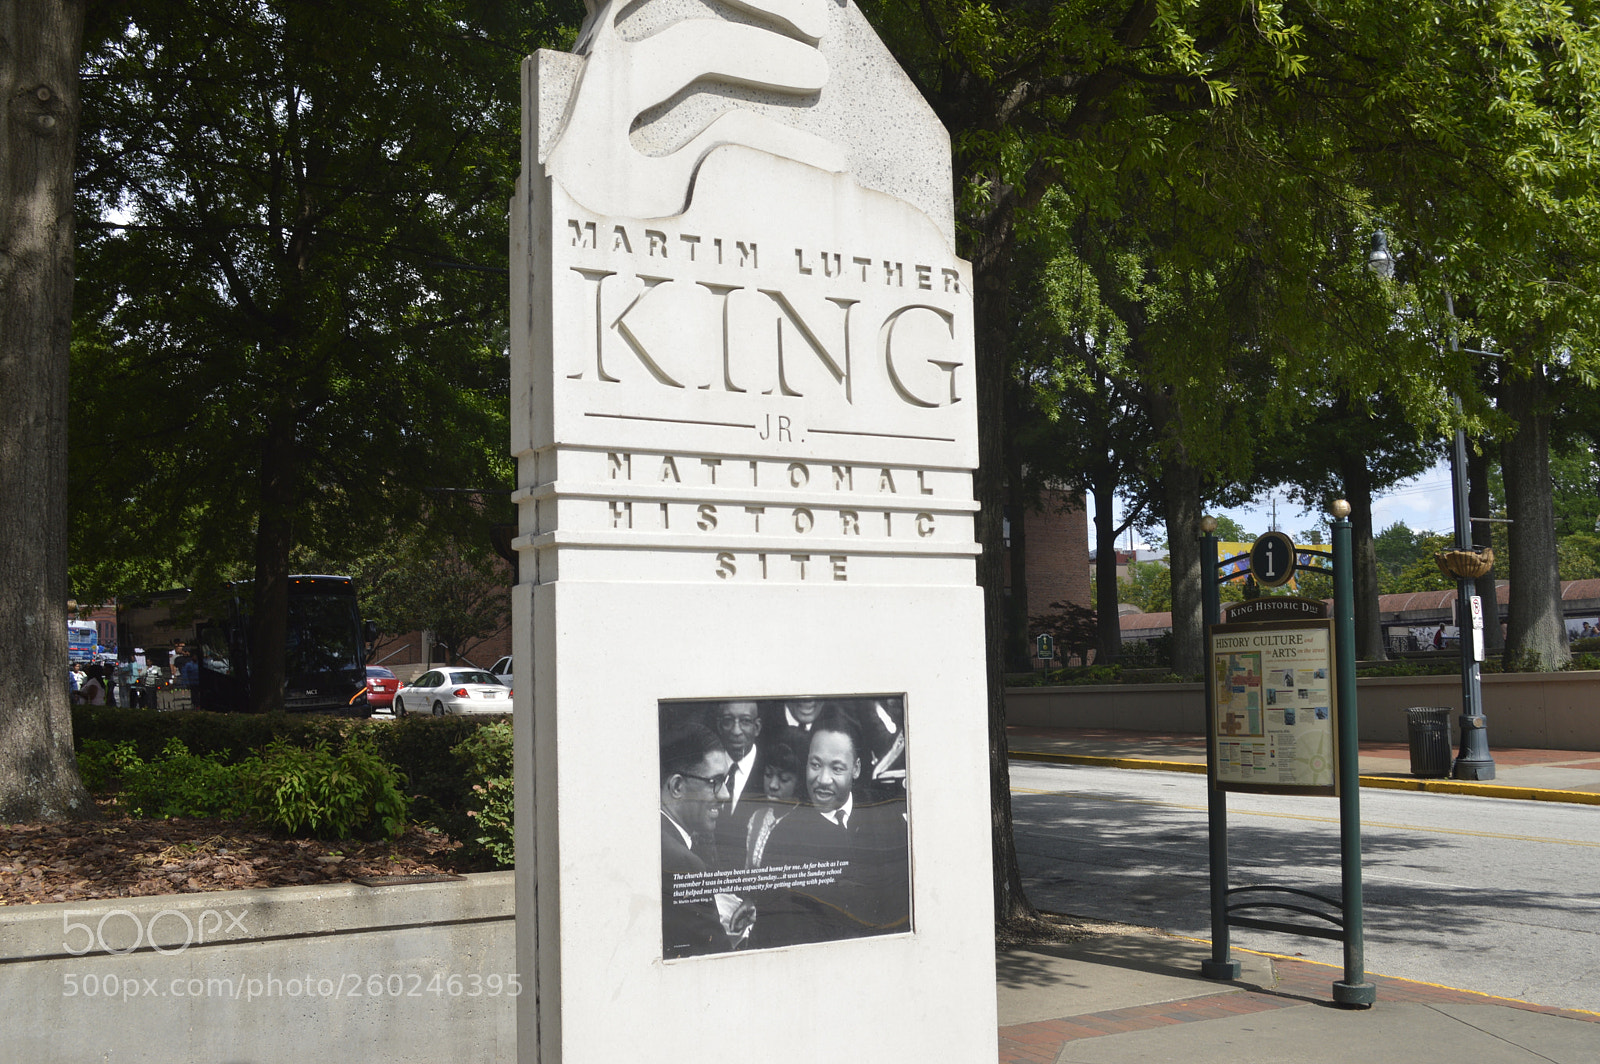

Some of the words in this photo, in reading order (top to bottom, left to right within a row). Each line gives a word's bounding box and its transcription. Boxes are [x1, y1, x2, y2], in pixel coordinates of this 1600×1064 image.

[568, 219, 758, 268] MARTIN
[795, 249, 961, 294] LUTHER
[566, 266, 964, 408] KING
[759, 413, 806, 443] JR.
[607, 452, 935, 496] NATIONAL
[609, 501, 936, 538] HISTORIC
[715, 551, 848, 582] SITE
[1231, 605, 1253, 618] KING
[1256, 602, 1298, 611] HISTORIC
[1216, 637, 1250, 648] HISTORY
[1253, 634, 1304, 646] CULTURE
[1272, 648, 1297, 658] ARTS
[673, 880, 702, 888] remember
[807, 870, 826, 878] Sunday
[750, 866, 768, 874] second
[685, 888, 704, 896] helped
[742, 883, 765, 892] capacity
[765, 882, 774, 890] for
[774, 880, 791, 889] getting
